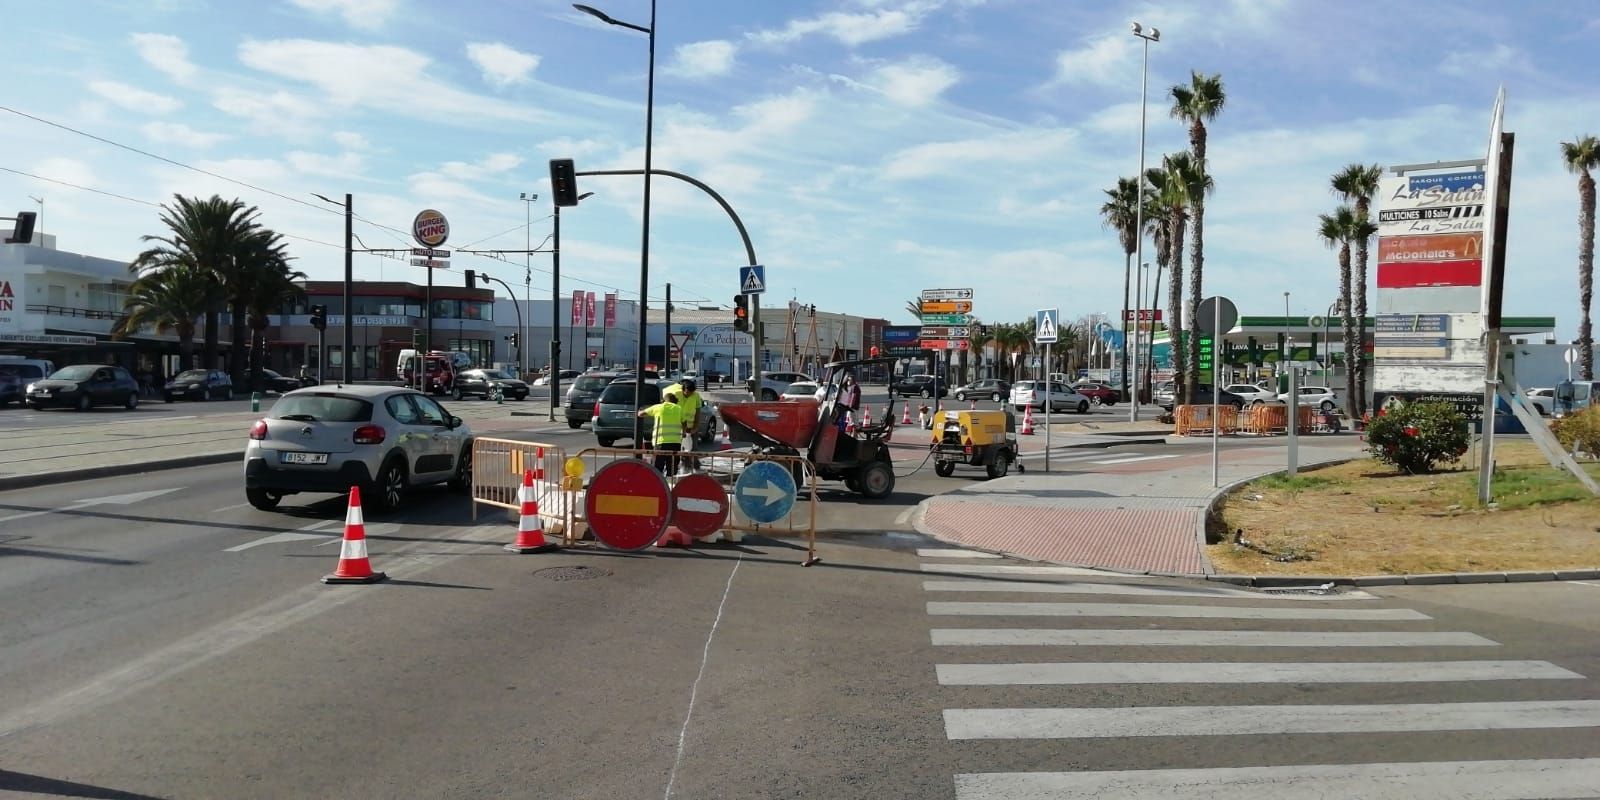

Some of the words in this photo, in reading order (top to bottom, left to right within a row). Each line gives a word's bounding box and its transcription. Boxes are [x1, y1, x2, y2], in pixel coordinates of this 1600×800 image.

[1391, 183, 1420, 201] La
[1416, 184, 1485, 207] Salin
[1380, 210, 1420, 221] MULTICINES
[1424, 210, 1432, 218] 10
[1432, 209, 1449, 218] Salas
[417, 217, 445, 229] BURGER
[1409, 221, 1430, 232] La
[419, 225, 446, 239] KING
[414, 248, 432, 256] AUTO
[287, 453, 306, 462] 8152
